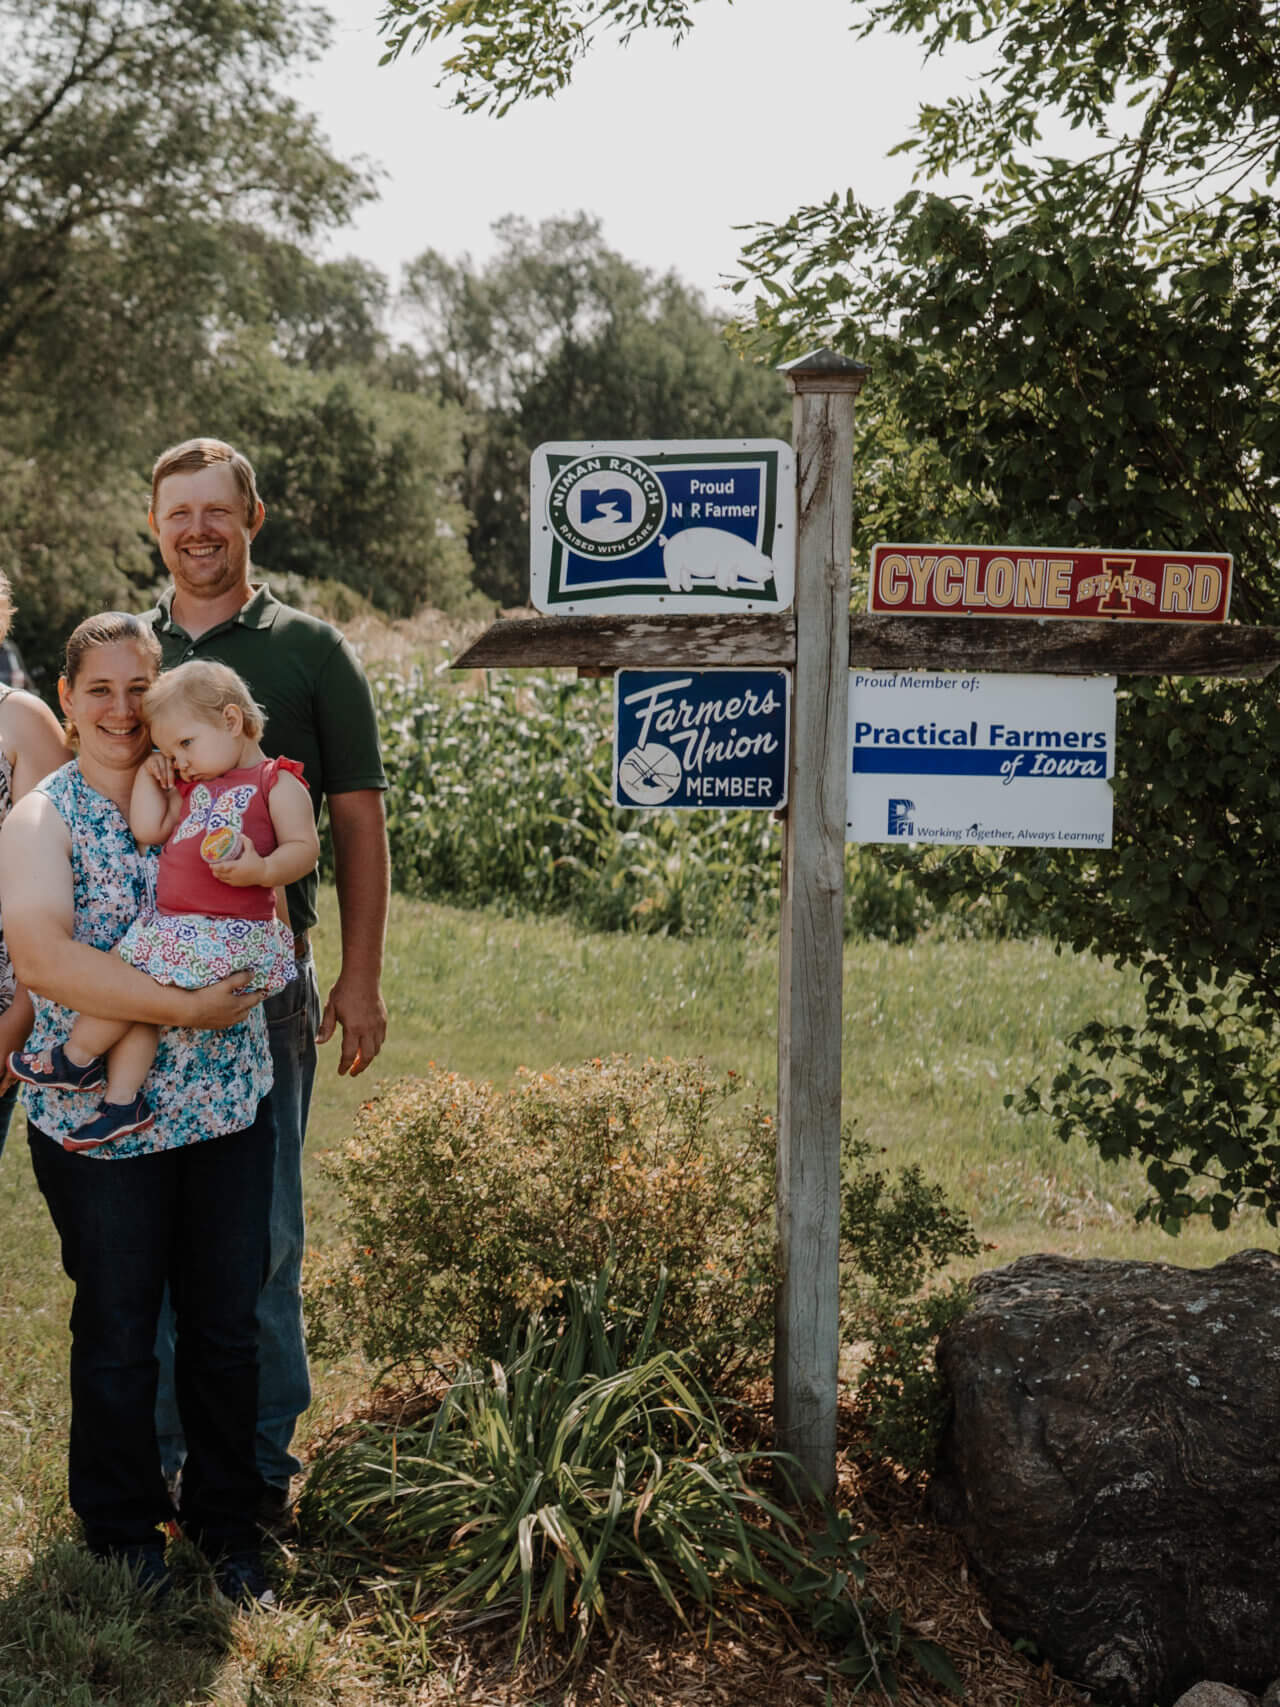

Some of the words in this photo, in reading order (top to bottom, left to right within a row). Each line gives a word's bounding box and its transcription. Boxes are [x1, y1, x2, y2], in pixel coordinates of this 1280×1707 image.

[552, 458, 601, 507] NIMAN
[609, 458, 660, 505] RANCH
[690, 479, 735, 495] Proud
[705, 501, 758, 518] Farmer
[559, 524, 595, 551] RAISED
[598, 544, 626, 553] WITH
[627, 523, 654, 547] CARE
[878, 553, 1075, 609] CYCLONE
[1160, 563, 1222, 613] RD
[1076, 573, 1157, 606] STATE
[855, 674, 896, 689] Proud
[900, 676, 958, 690] Member
[961, 677, 980, 692] of:
[624, 678, 781, 751] Farmers
[855, 721, 977, 747] Practical
[989, 725, 1107, 748] Farmers
[669, 727, 779, 774] Union
[1000, 754, 1024, 785] of
[1029, 754, 1104, 776] Iowa
[686, 777, 773, 798] MEMBER
[917, 827, 962, 840] Working
[965, 828, 1015, 841] Together,
[1017, 829, 1056, 841] Always
[1057, 830, 1105, 844] Learning
